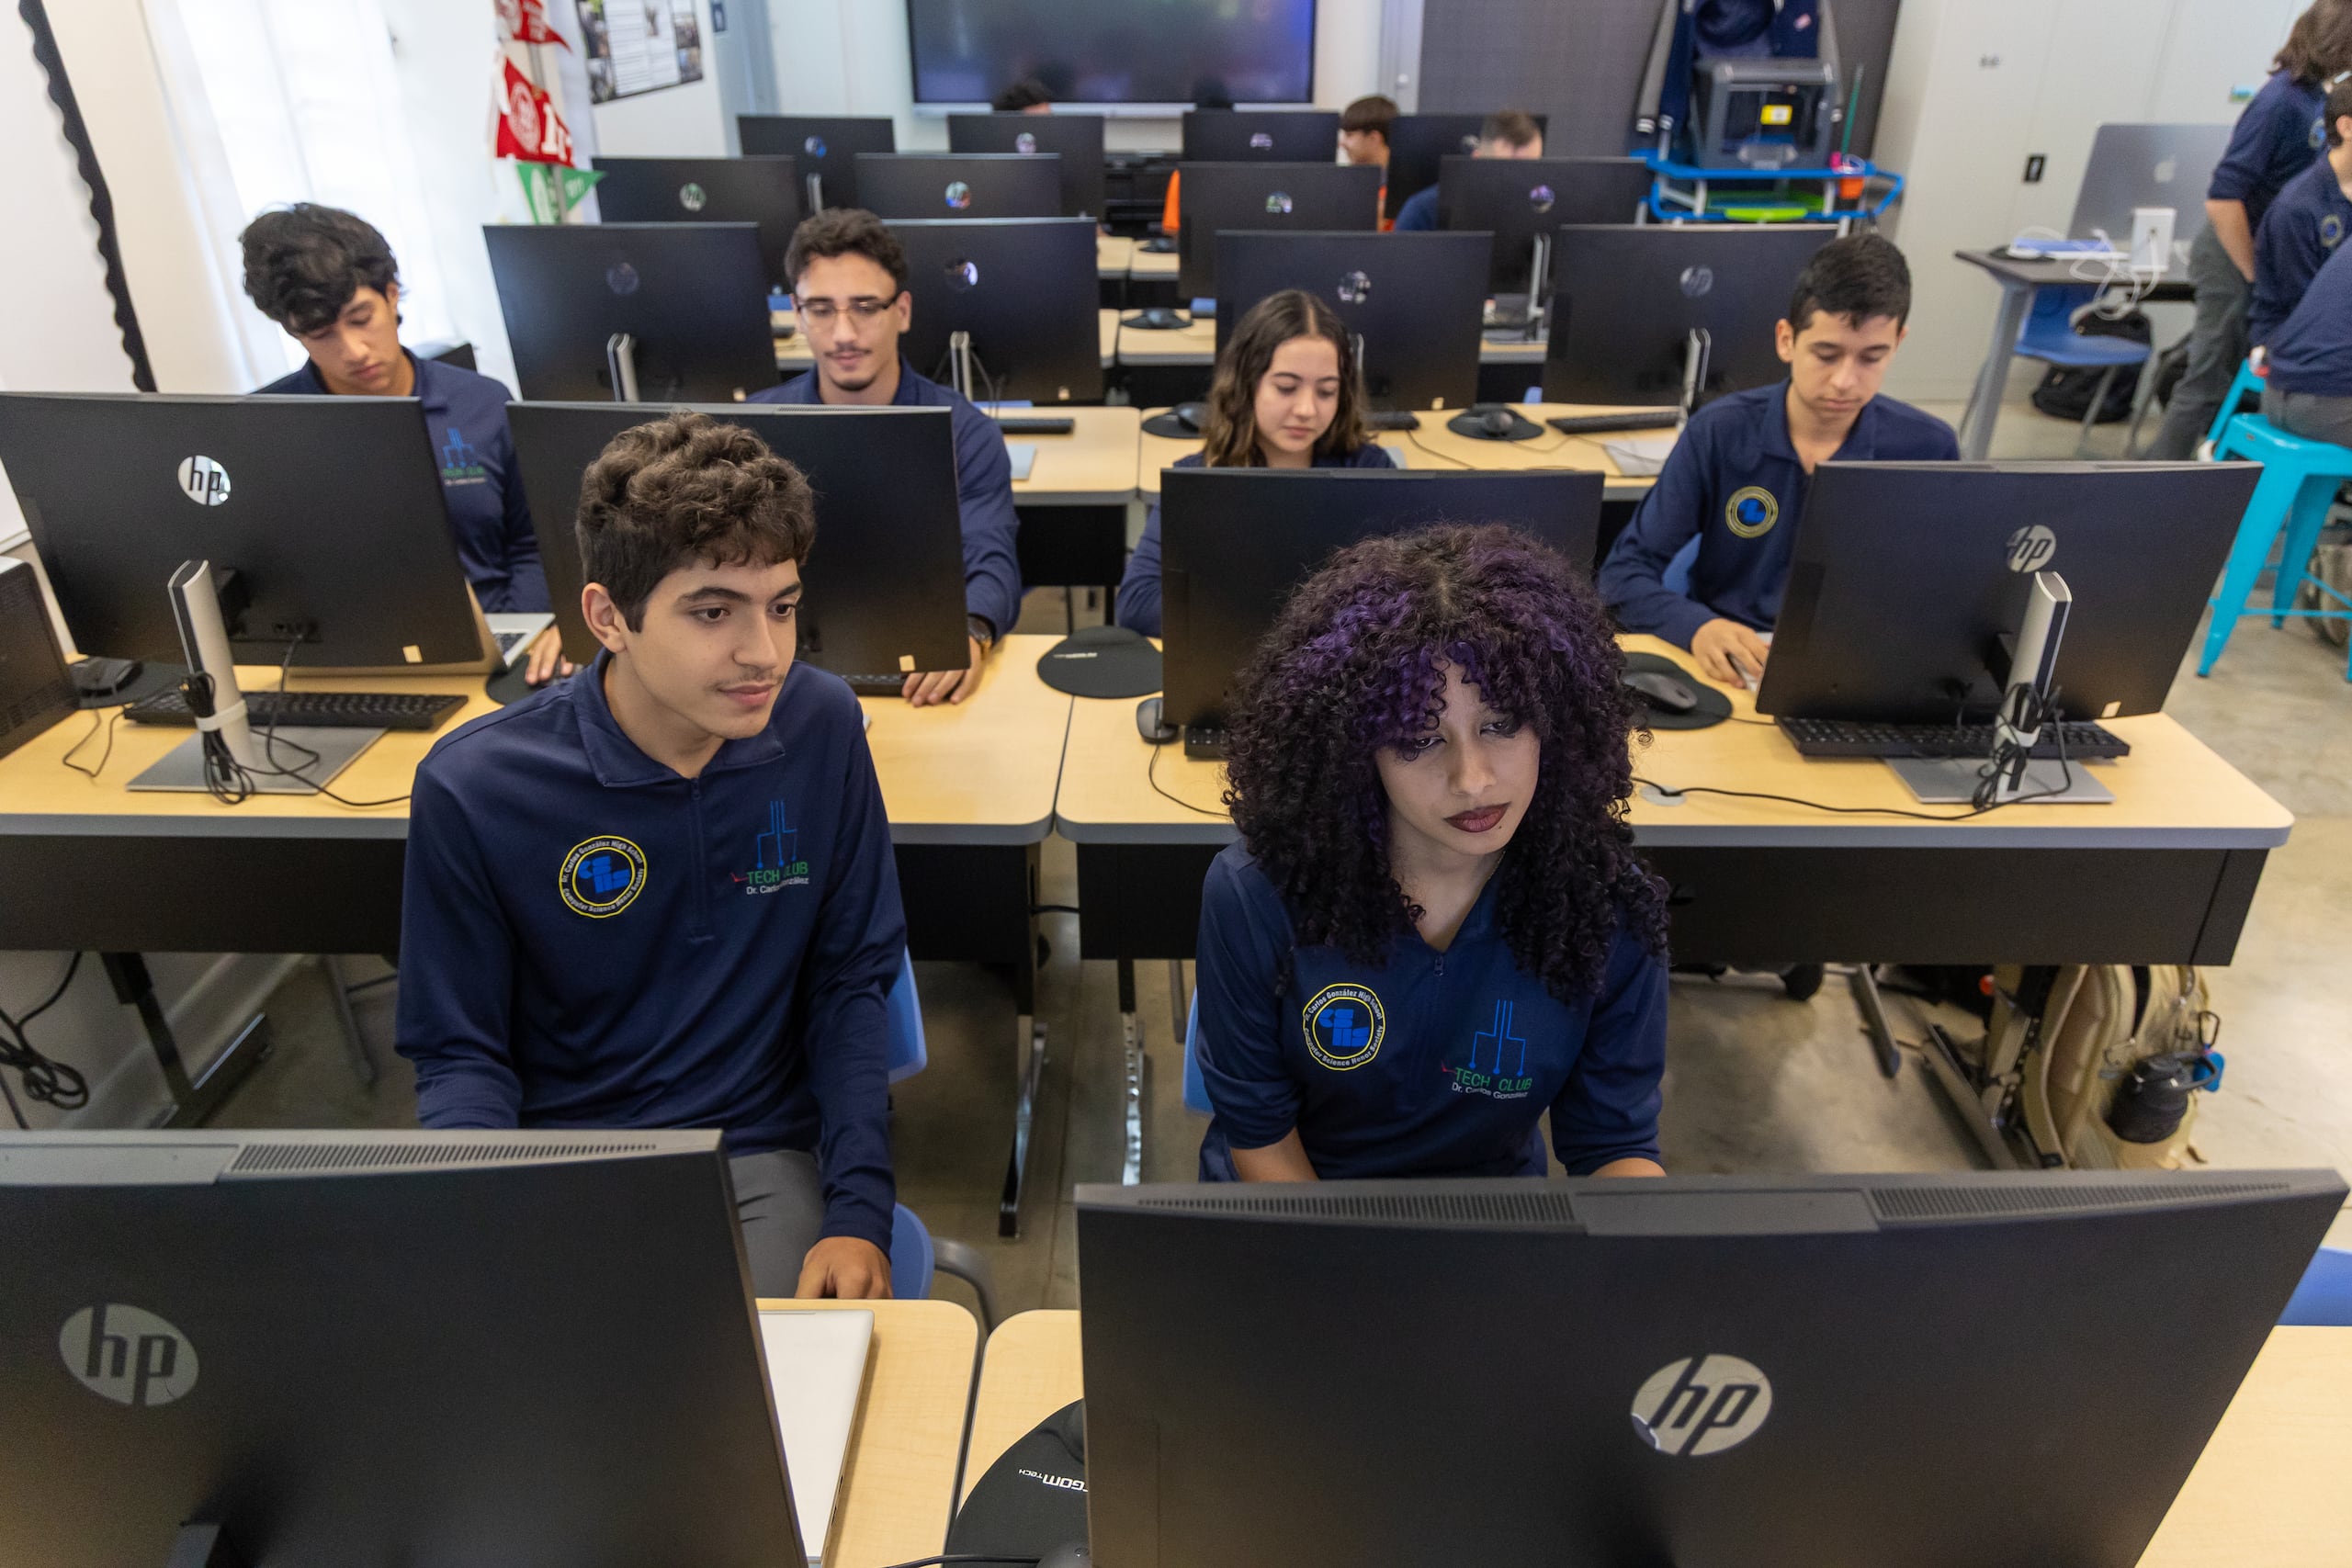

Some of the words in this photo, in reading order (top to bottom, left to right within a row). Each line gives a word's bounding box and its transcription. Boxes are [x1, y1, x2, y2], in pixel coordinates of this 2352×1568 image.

[187, 456, 222, 506] hp
[2009, 525, 2052, 572] hp
[746, 886, 758, 895] Dr.
[747, 869, 780, 885] TECH
[1308, 996, 1327, 1014] Carlos
[1327, 989, 1357, 999] González
[1359, 991, 1372, 1002] High
[1322, 1055, 1351, 1066] Science
[1351, 1051, 1372, 1064] Honor
[1370, 1025, 1384, 1053] Society
[1452, 1082, 1463, 1093] Dr.
[1456, 1067, 1490, 1087] TECH
[1498, 1077, 1532, 1091] CLUB
[85, 1305, 177, 1406] hp
[1648, 1354, 1759, 1457] hp
